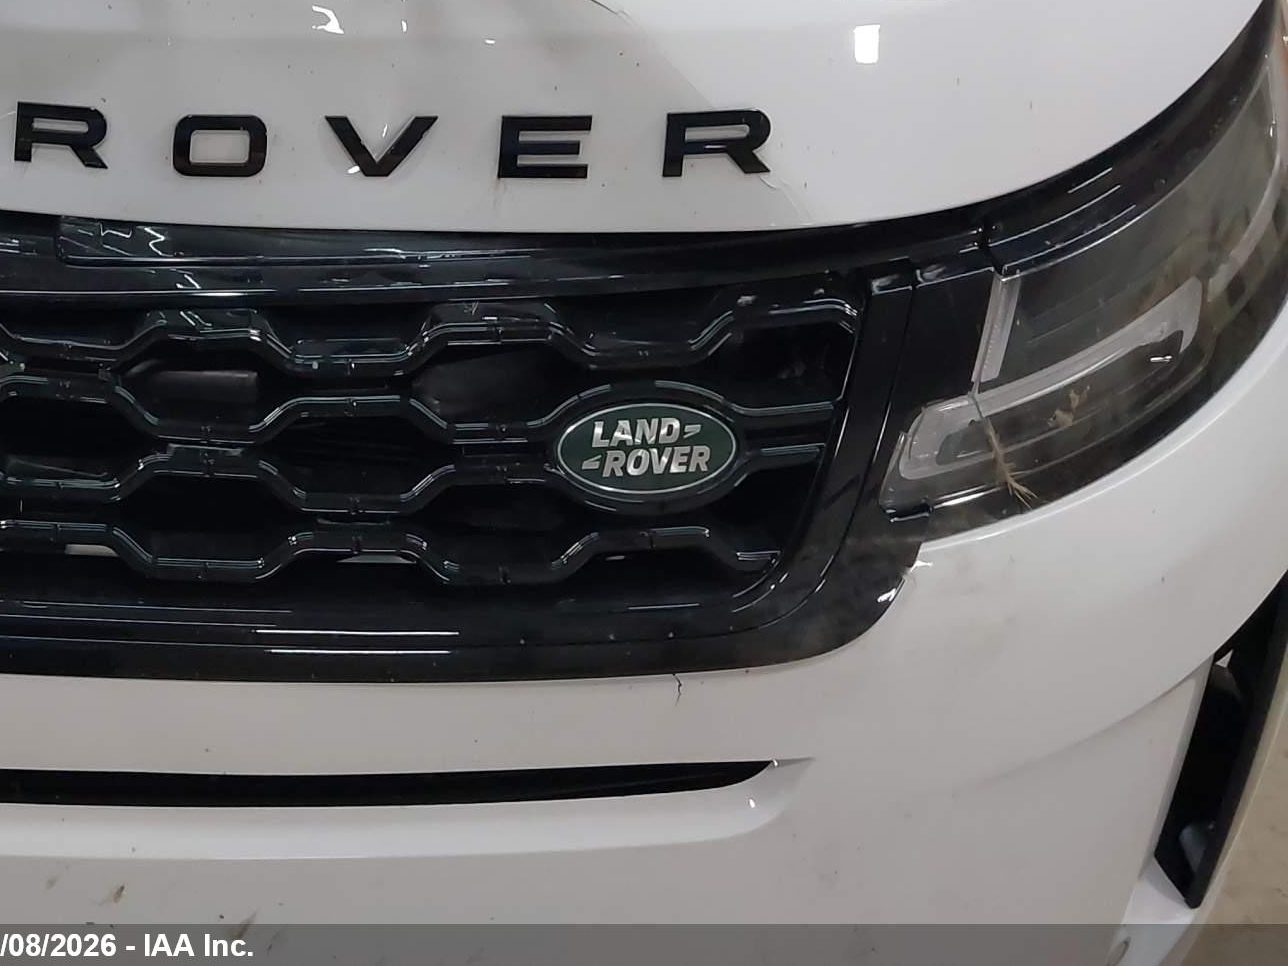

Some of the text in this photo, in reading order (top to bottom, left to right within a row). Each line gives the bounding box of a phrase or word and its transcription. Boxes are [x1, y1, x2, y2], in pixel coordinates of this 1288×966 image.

[14, 101, 773, 179] ROVER
[592, 417, 681, 448] LAND
[602, 445, 712, 478] ROVER
